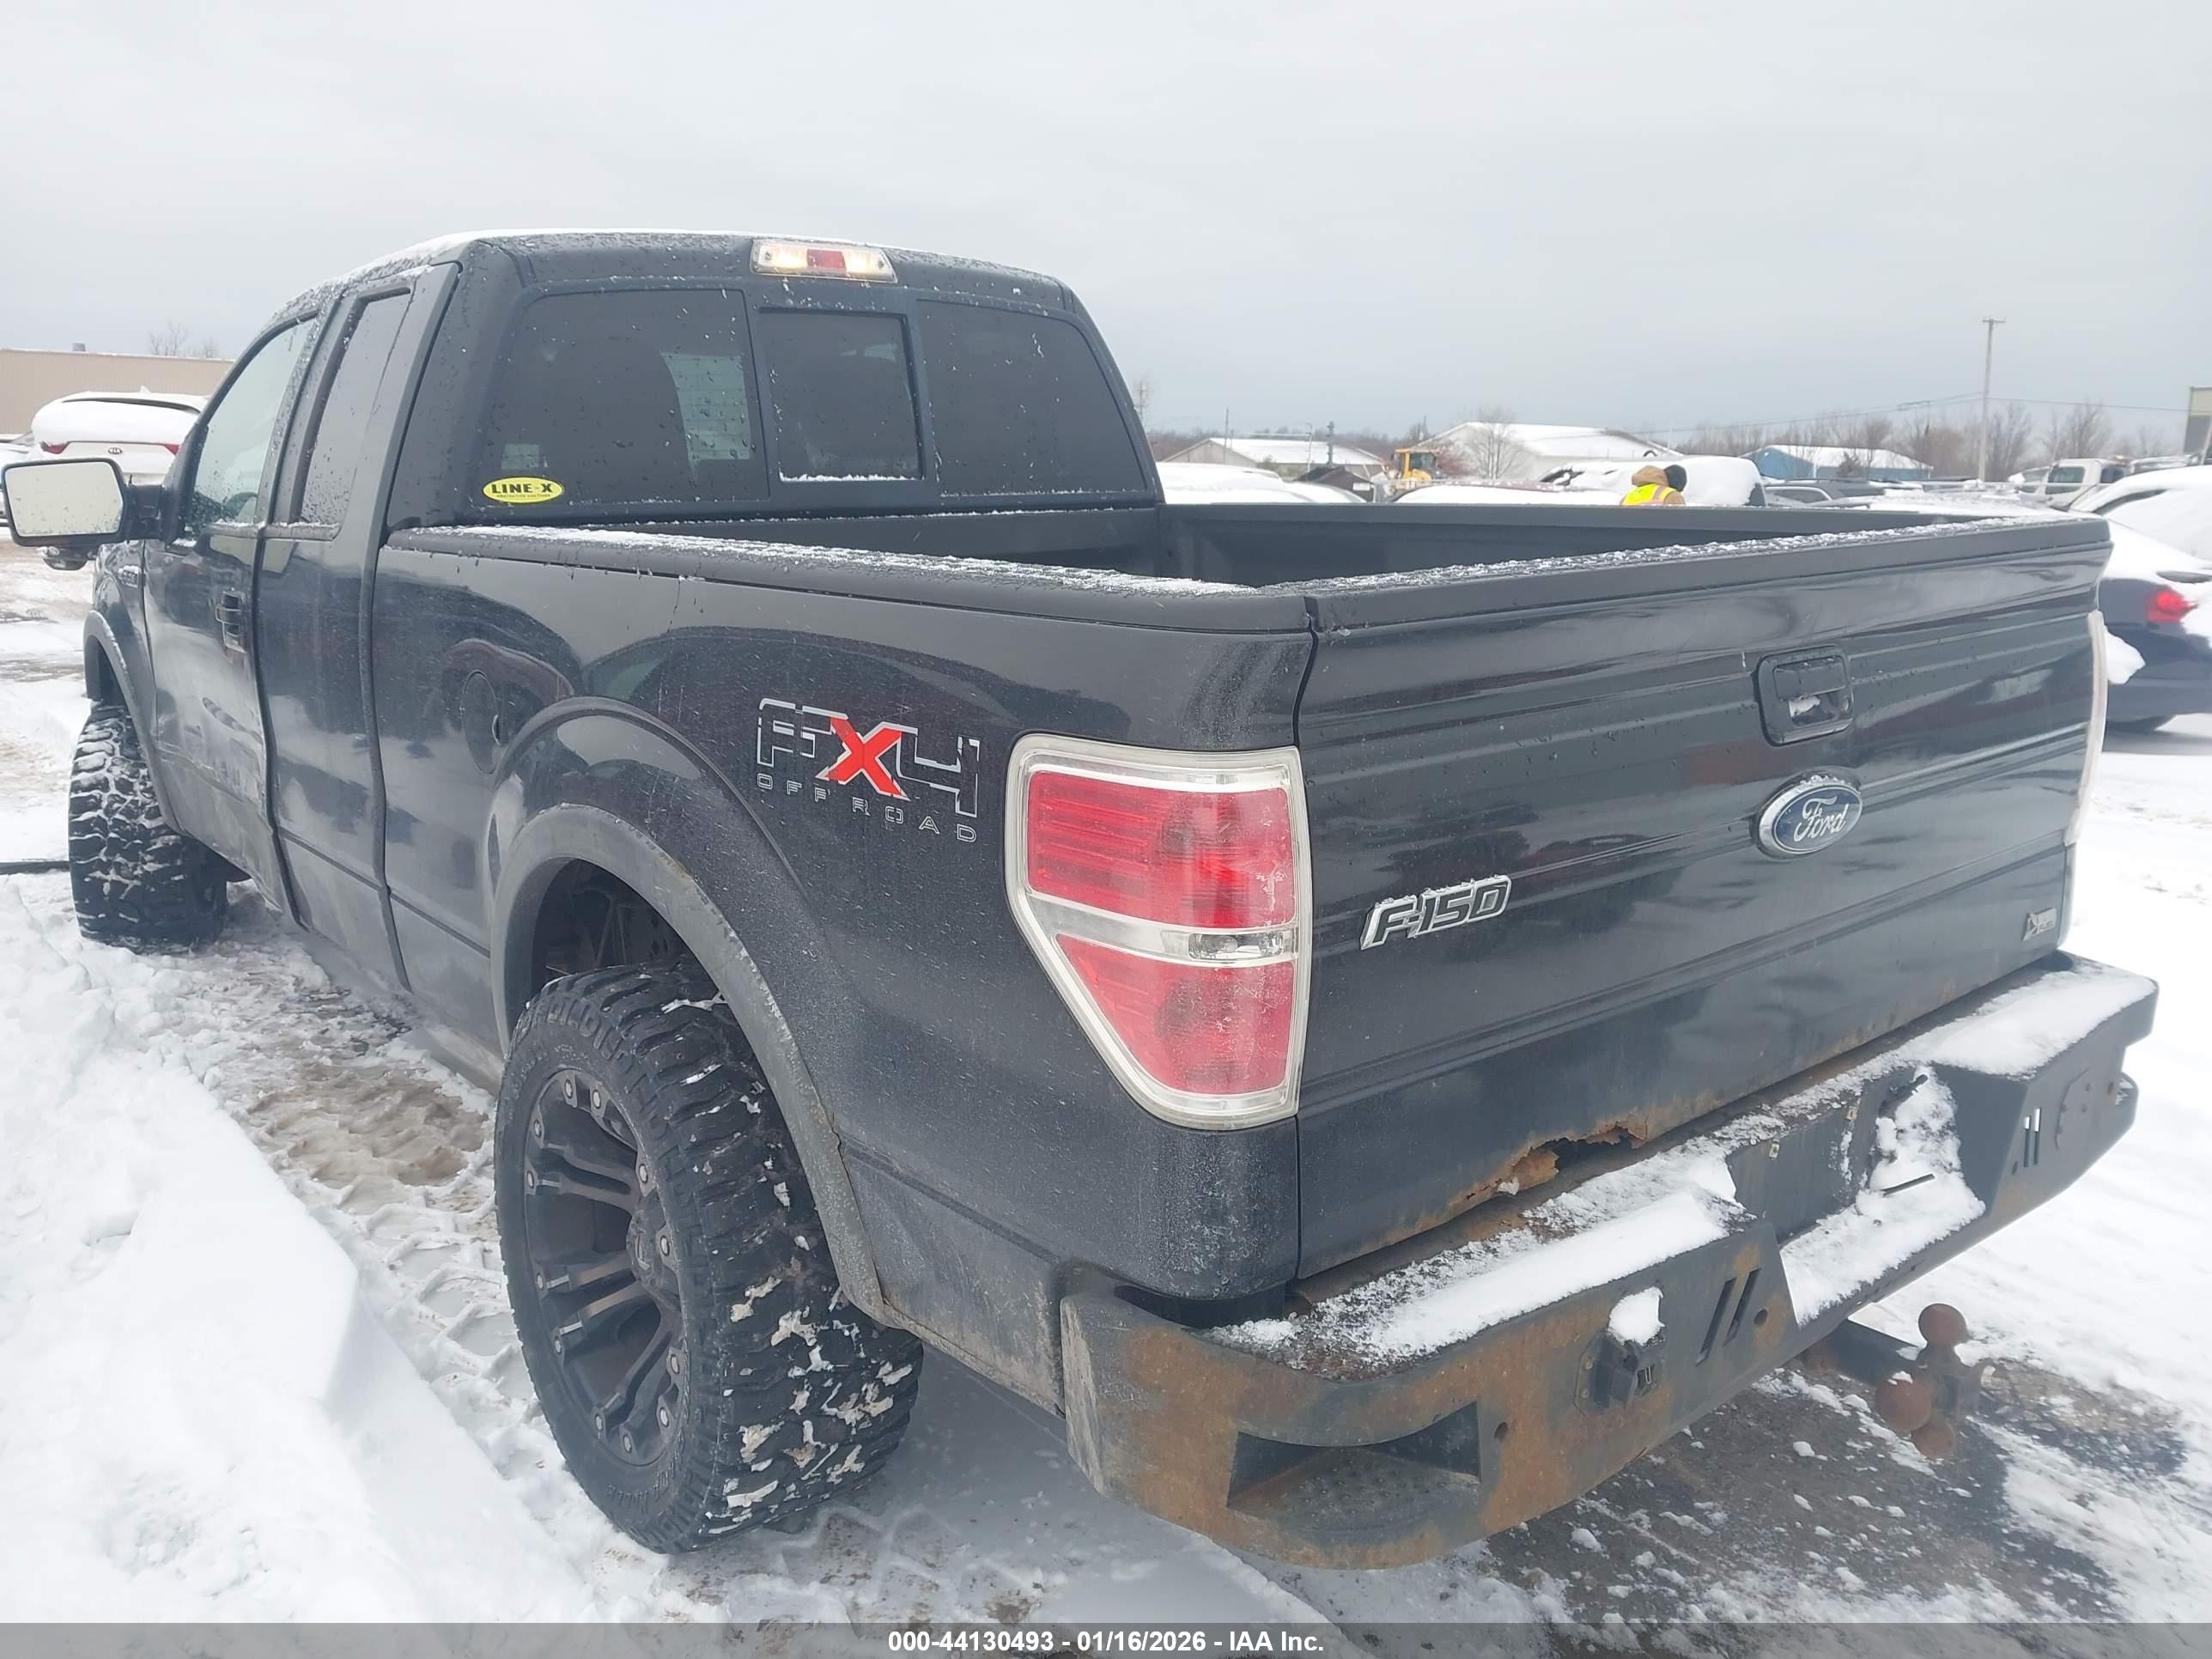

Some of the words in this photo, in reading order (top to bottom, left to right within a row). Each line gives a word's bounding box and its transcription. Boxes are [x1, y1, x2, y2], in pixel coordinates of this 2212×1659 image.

[491, 483, 554, 494] LINE-X
[757, 698, 980, 817] FX4
[1793, 795, 1850, 842] Ford
[1360, 874, 1512, 950] F-150
